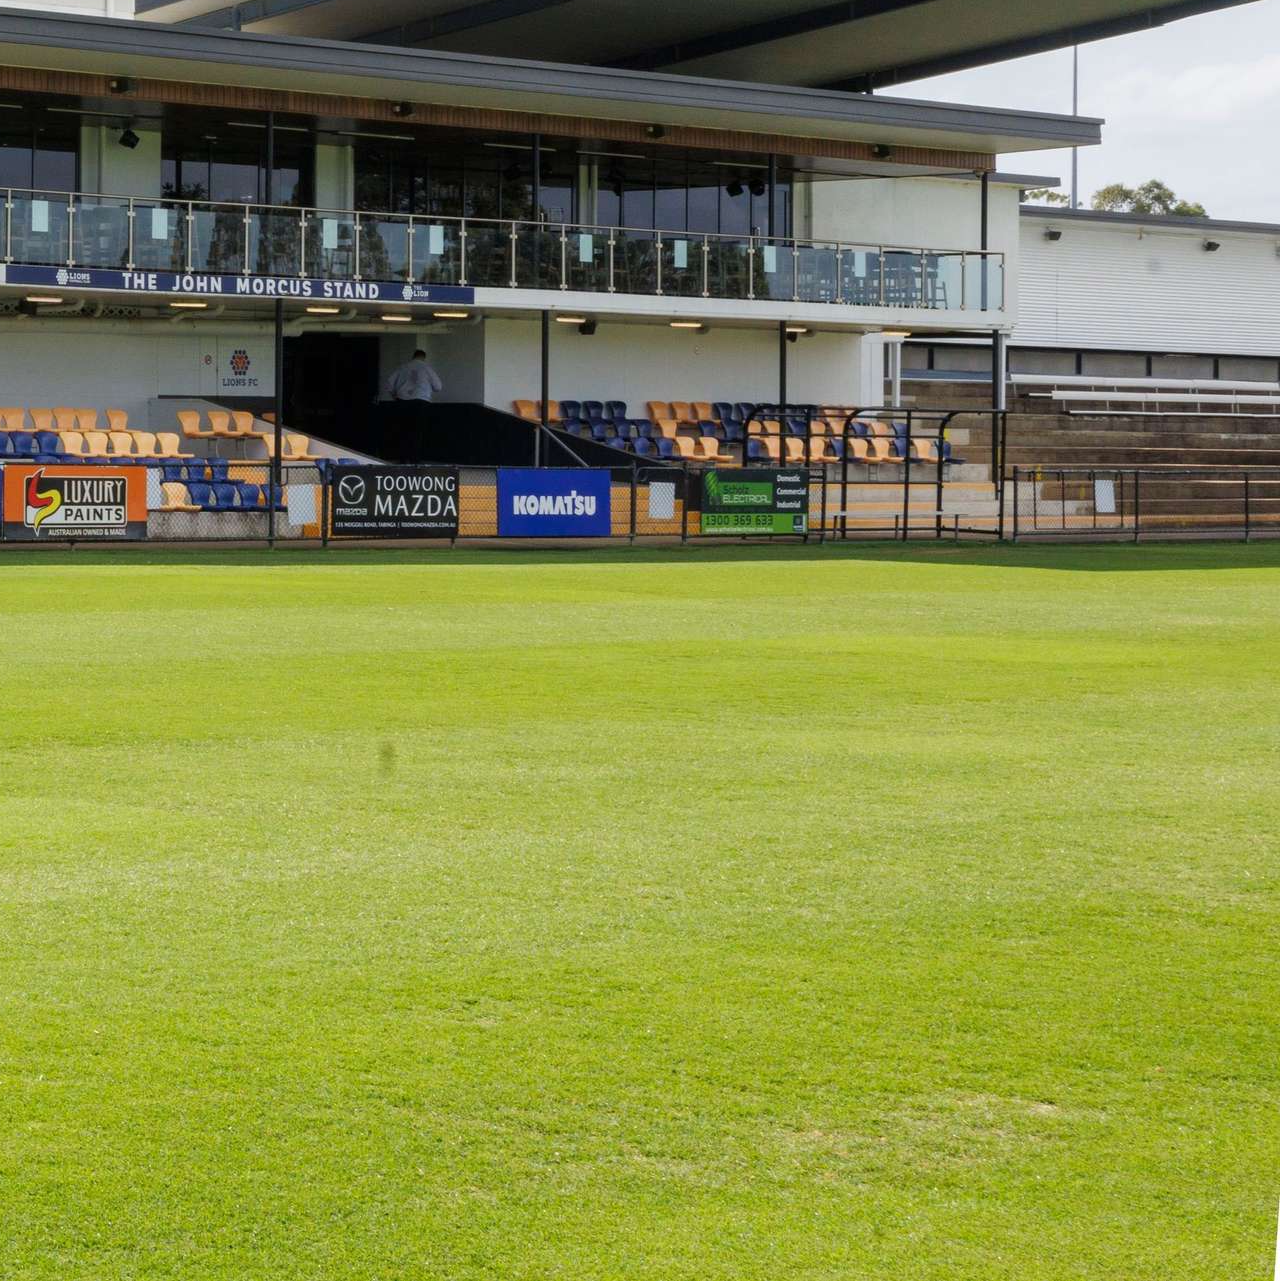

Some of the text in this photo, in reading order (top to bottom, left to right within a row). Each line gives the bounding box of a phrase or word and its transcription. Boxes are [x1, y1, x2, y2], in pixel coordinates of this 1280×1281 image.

[69, 272, 90, 281] LIONS
[122, 272, 380, 300] THE JOHN MORCUS STAND
[222, 378, 259, 387] LIONS FC
[375, 475, 456, 492] TOOWONG
[776, 474, 801, 482] Domestic
[63, 480, 123, 503] LUXURY
[776, 487, 807, 495] Commercial
[374, 494, 457, 517] MAZDA
[513, 489, 597, 516] KOMATSU
[776, 500, 801, 508] Industrial
[63, 508, 123, 521] PAINTS
[706, 515, 774, 526] 1300 369 633
[48, 528, 81, 536] AUSTRALIAN
[83, 528, 103, 536] OWNED
[110, 528, 127, 536] MADE
